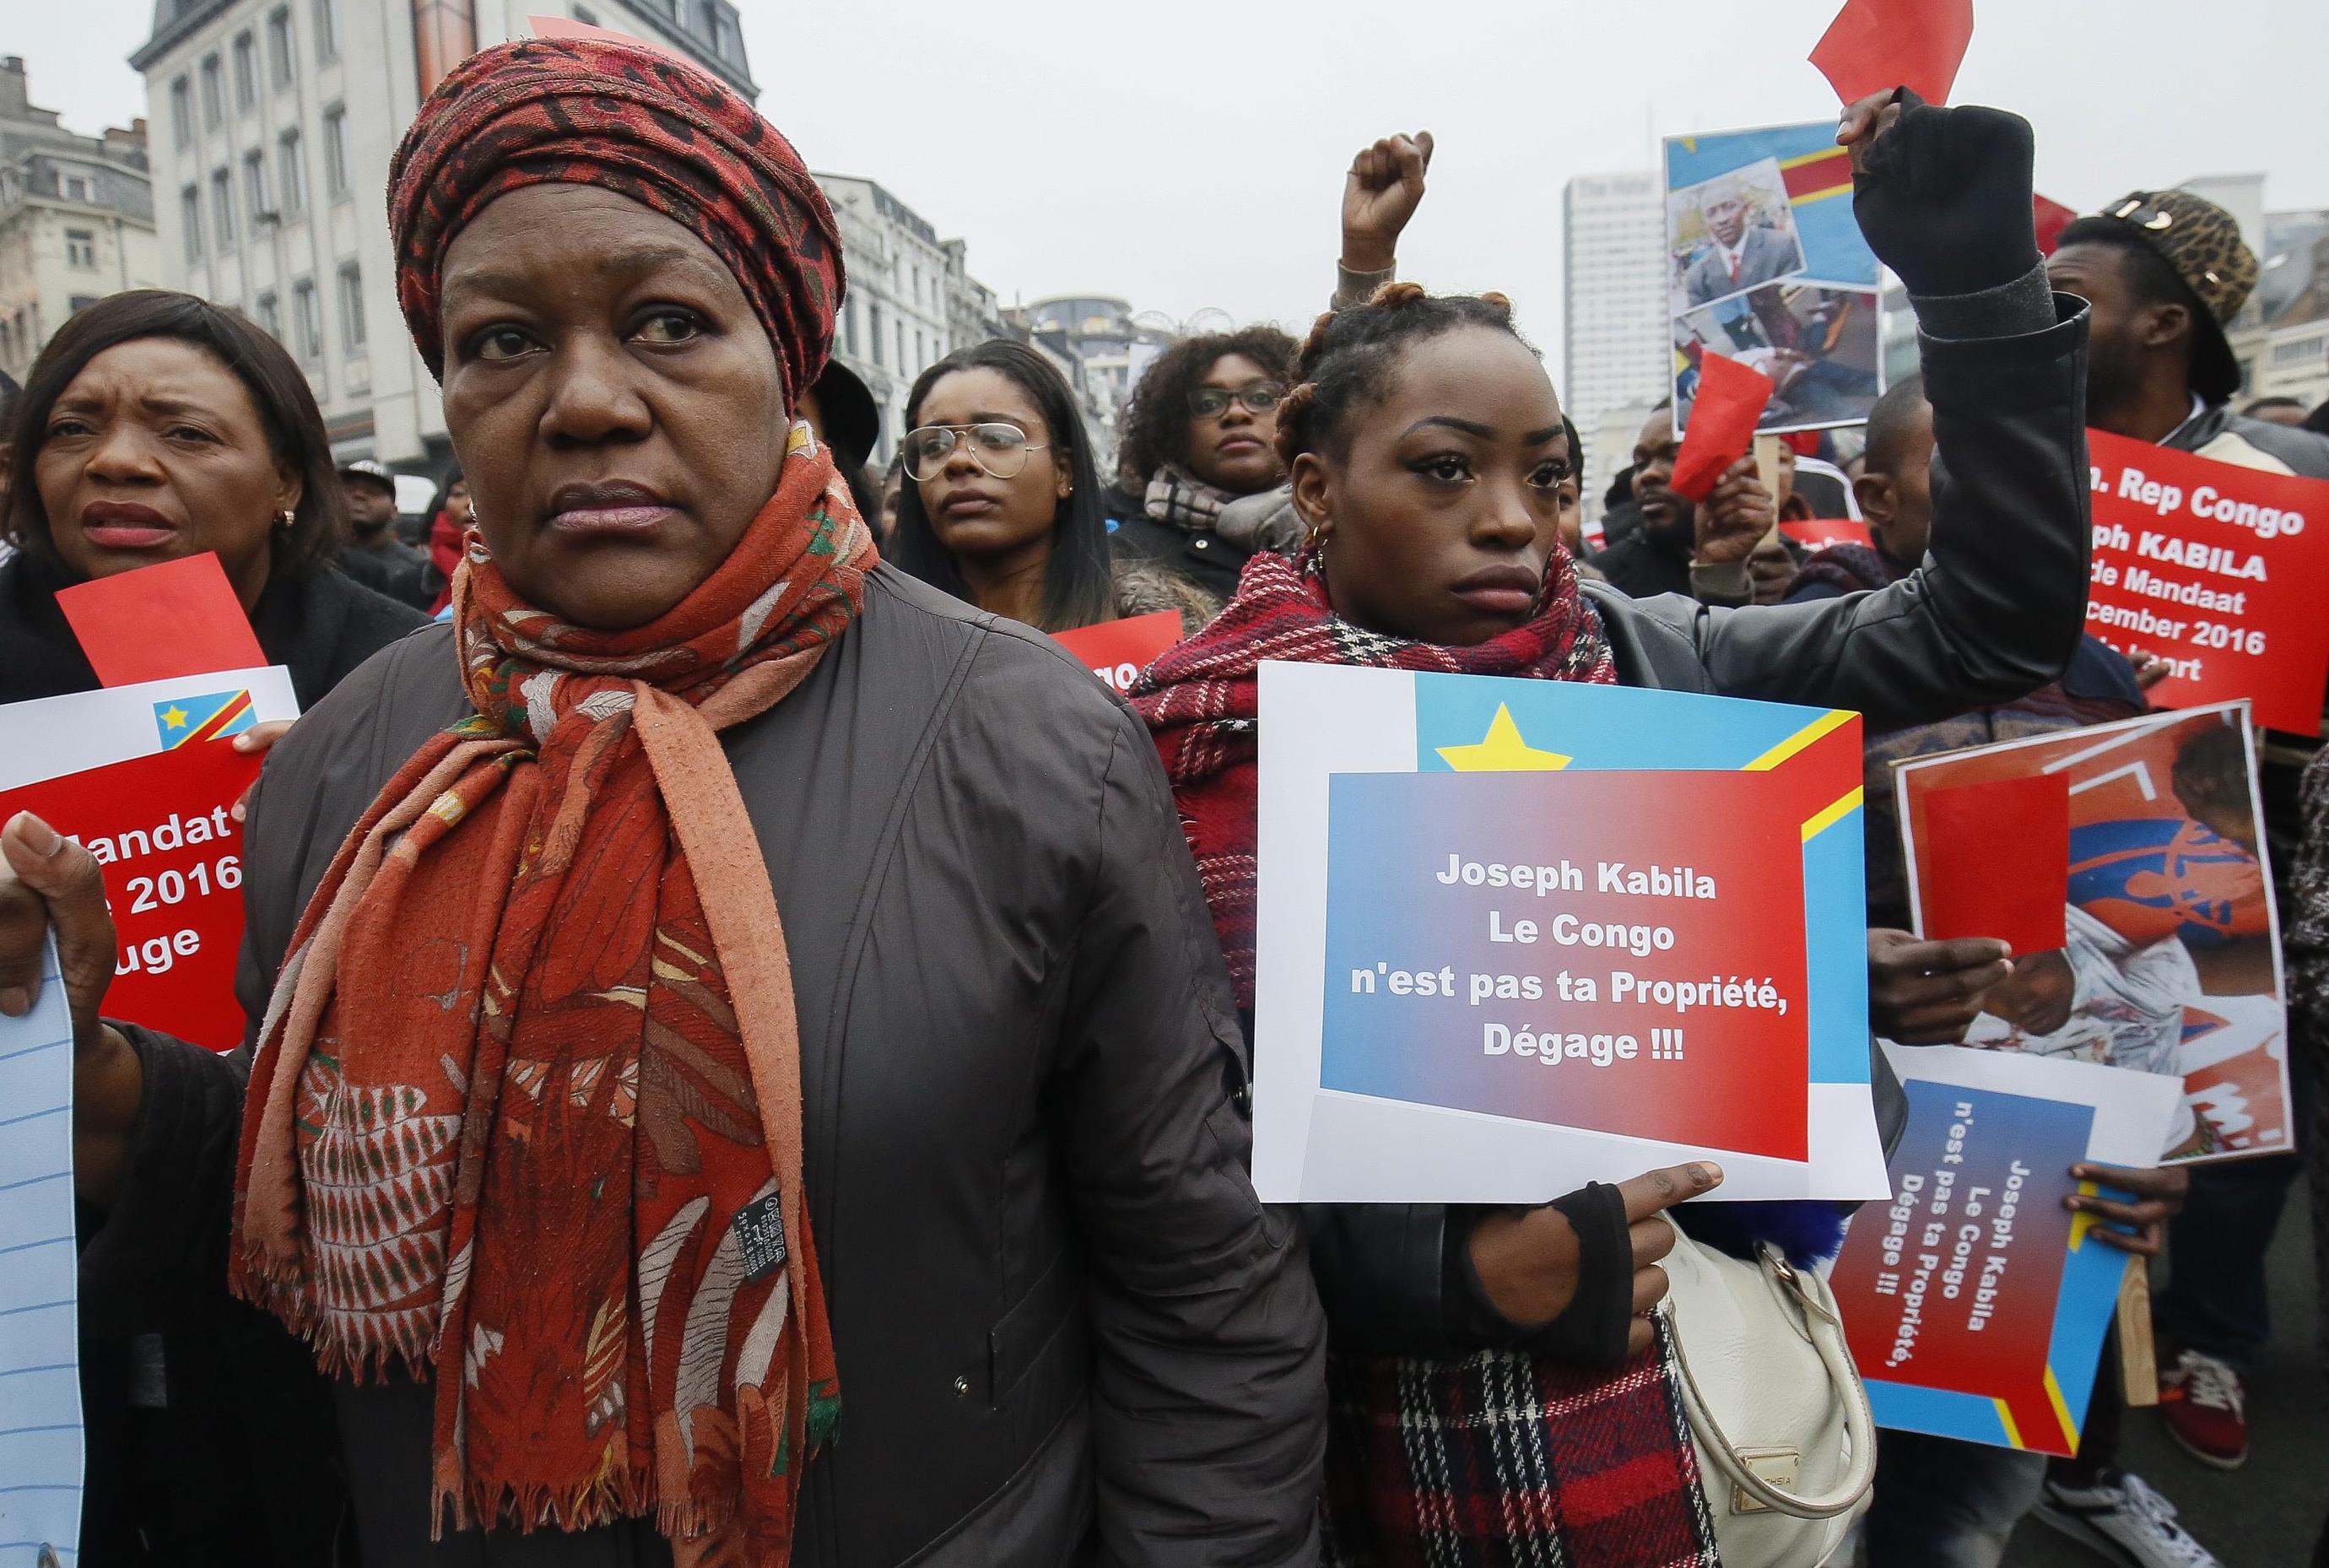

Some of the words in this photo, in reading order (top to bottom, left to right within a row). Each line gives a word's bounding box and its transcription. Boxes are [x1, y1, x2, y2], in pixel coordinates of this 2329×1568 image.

[2118, 467, 2182, 516] Rep
[2191, 486, 2305, 538] Congo
[2092, 523, 2131, 551] ph
[2137, 531, 2267, 581] KABILA
[2123, 566, 2245, 615] Mandaat
[2085, 601, 2187, 640] cember
[2191, 621, 2266, 655] 2016
[126, 856, 243, 914] 2016
[1435, 853, 1584, 897] Joseph
[1597, 861, 1717, 900] Kabila
[114, 929, 200, 975] uge
[1489, 911, 1539, 944] Le
[1551, 914, 1675, 957] Congo
[1351, 962, 1456, 998] n'est
[1469, 973, 1544, 1006] pas
[1556, 970, 1598, 1003] ta
[1610, 971, 1787, 1015] Propriété,
[1483, 1023, 1639, 1067] Dégage
[1651, 1028, 1684, 1060] !!!
[1943, 1101, 1974, 1165] n'est
[1930, 1170, 1957, 1215] pas
[1964, 1186, 1991, 1218] Le
[1990, 1160, 2030, 1249] Joseph
[1881, 1173, 1925, 1267] Dégage
[1921, 1222, 1947, 1247] ta
[1874, 1271, 1900, 1295] !!!
[1943, 1224, 1980, 1300] Congo
[1884, 1253, 1940, 1368] Propriété,
[1967, 1255, 2007, 1331] Kabila
